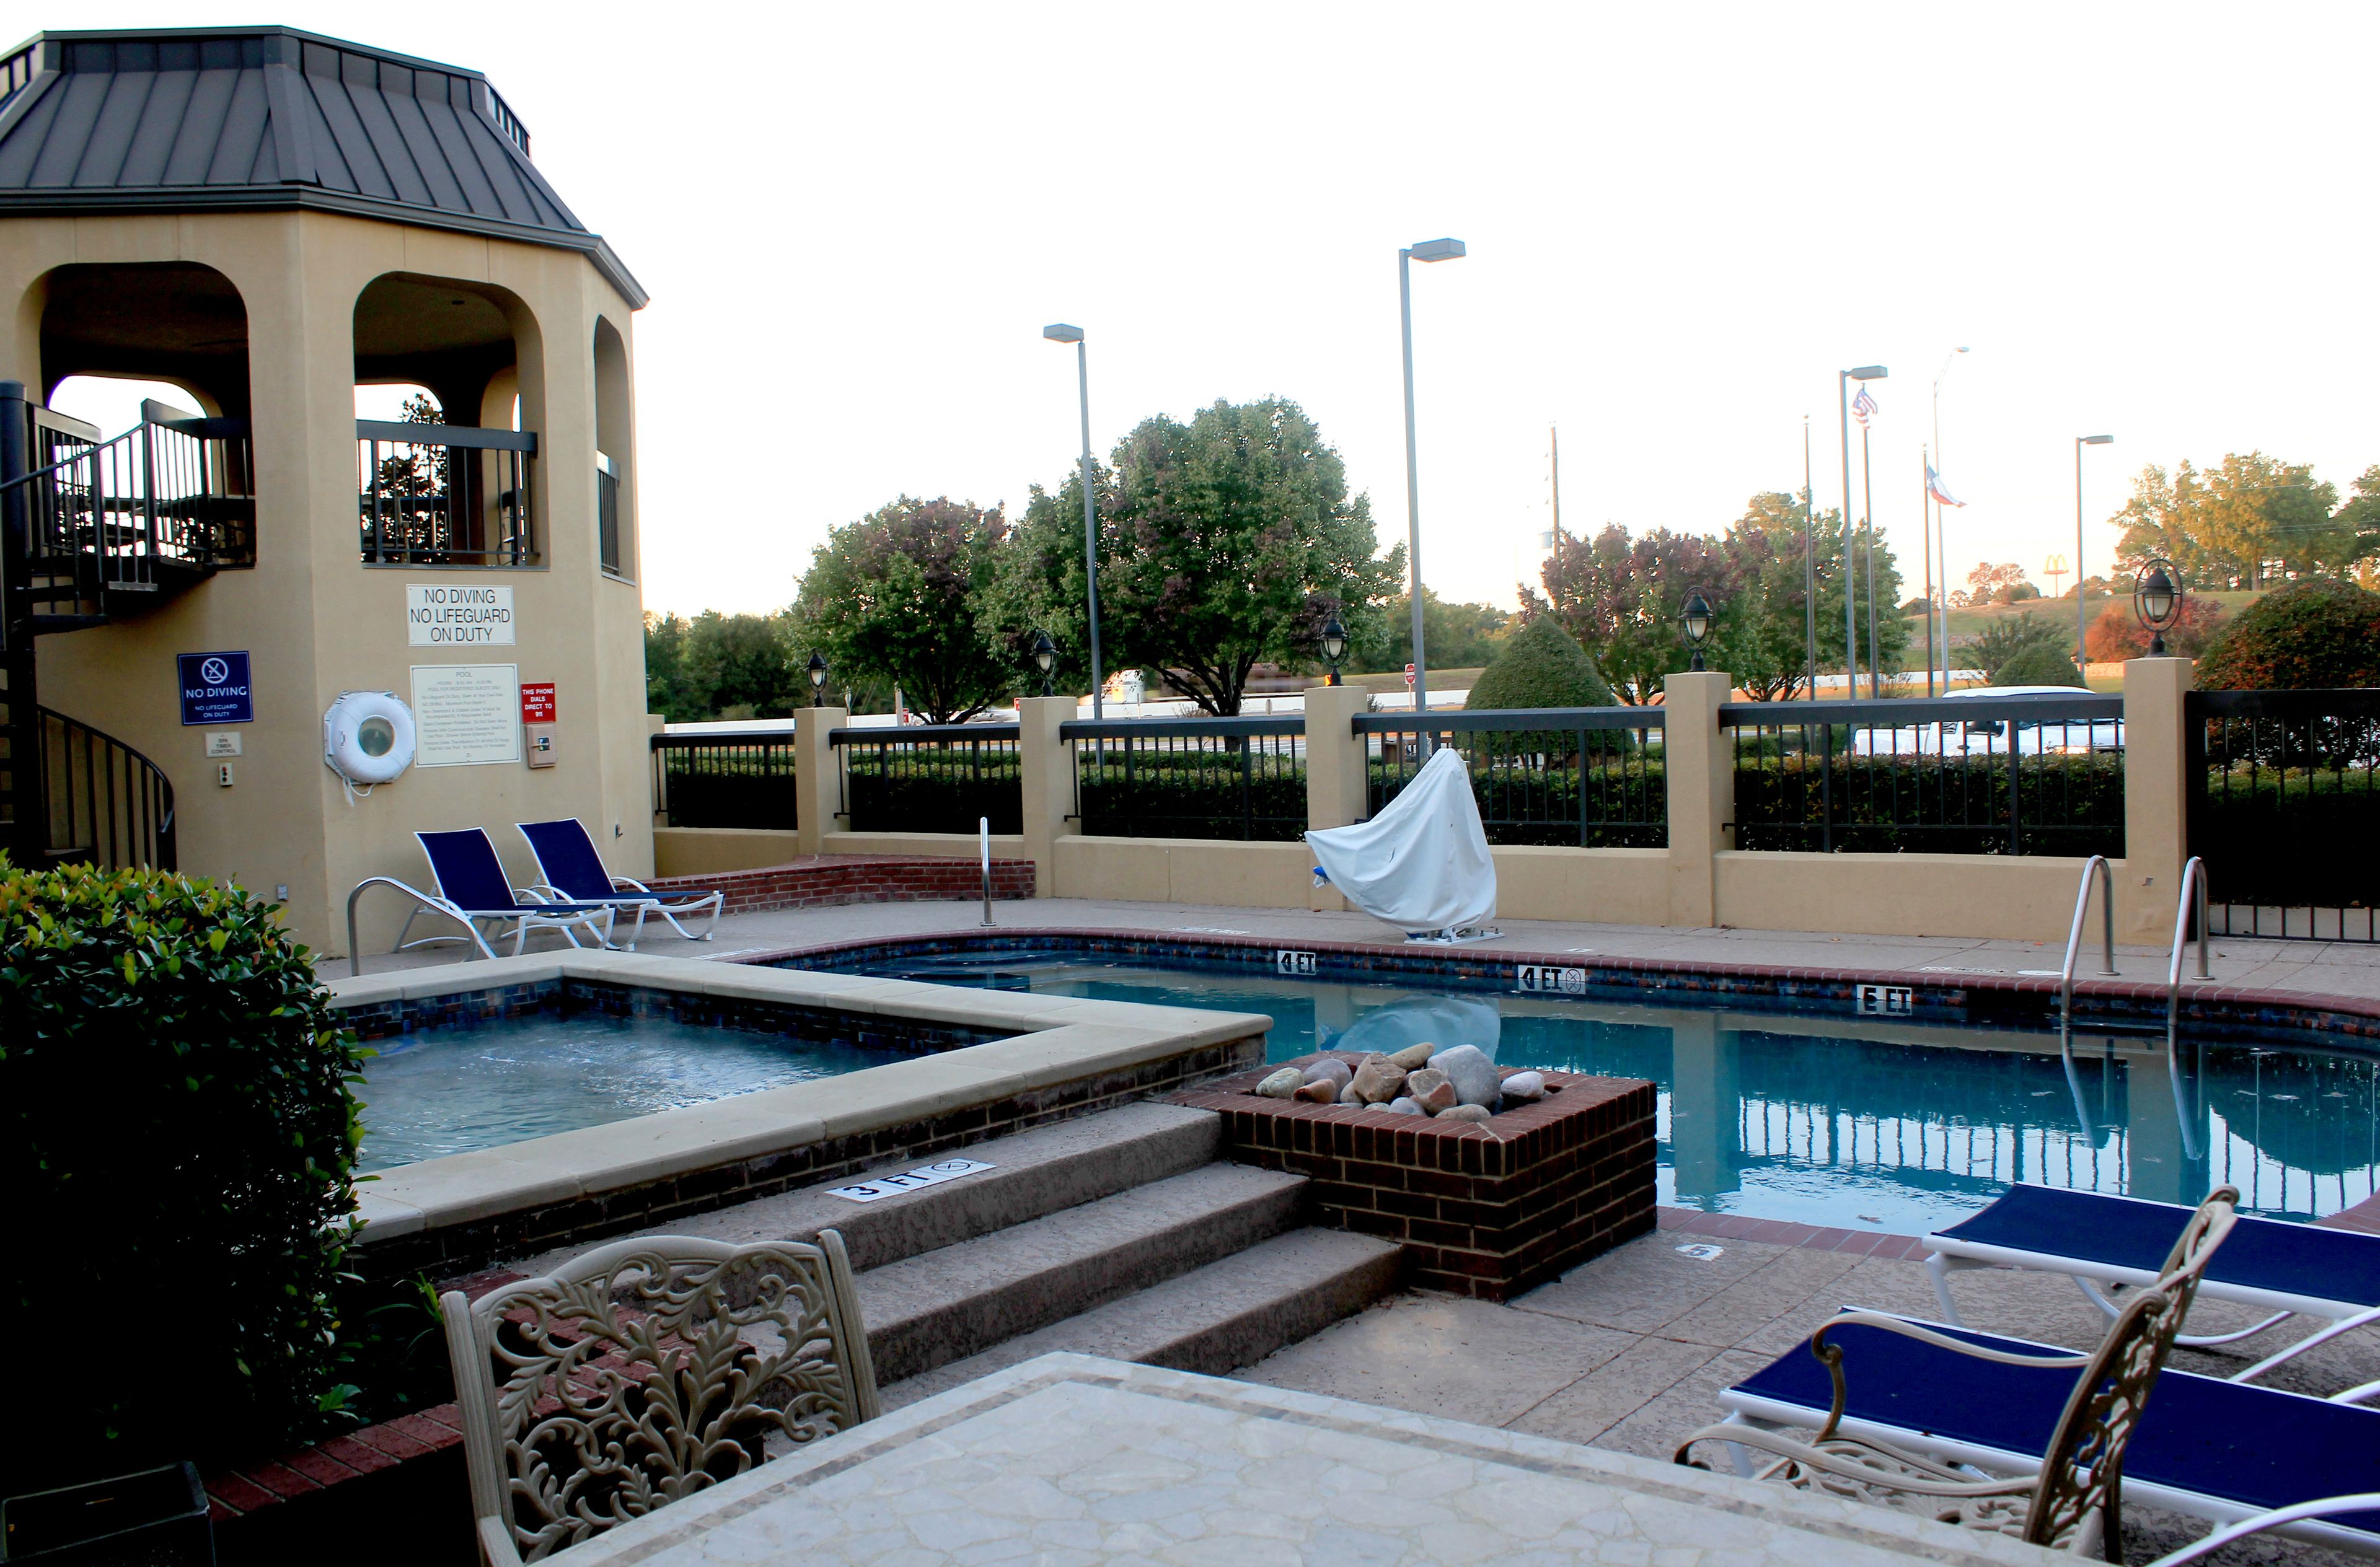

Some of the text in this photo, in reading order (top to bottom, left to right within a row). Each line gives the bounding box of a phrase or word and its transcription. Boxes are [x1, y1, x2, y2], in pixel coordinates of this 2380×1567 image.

[425, 589, 495, 604] NO DIVING
[411, 608, 511, 623] NO LIFEGUARD
[431, 627, 493, 642] ON DUTY
[186, 686, 247, 698] NO DIVING
[1281, 953, 1292, 965] 4
[1522, 967, 1535, 981] 4
[1864, 986, 1877, 1001] 5
[843, 1170, 930, 1196] 3 FT
